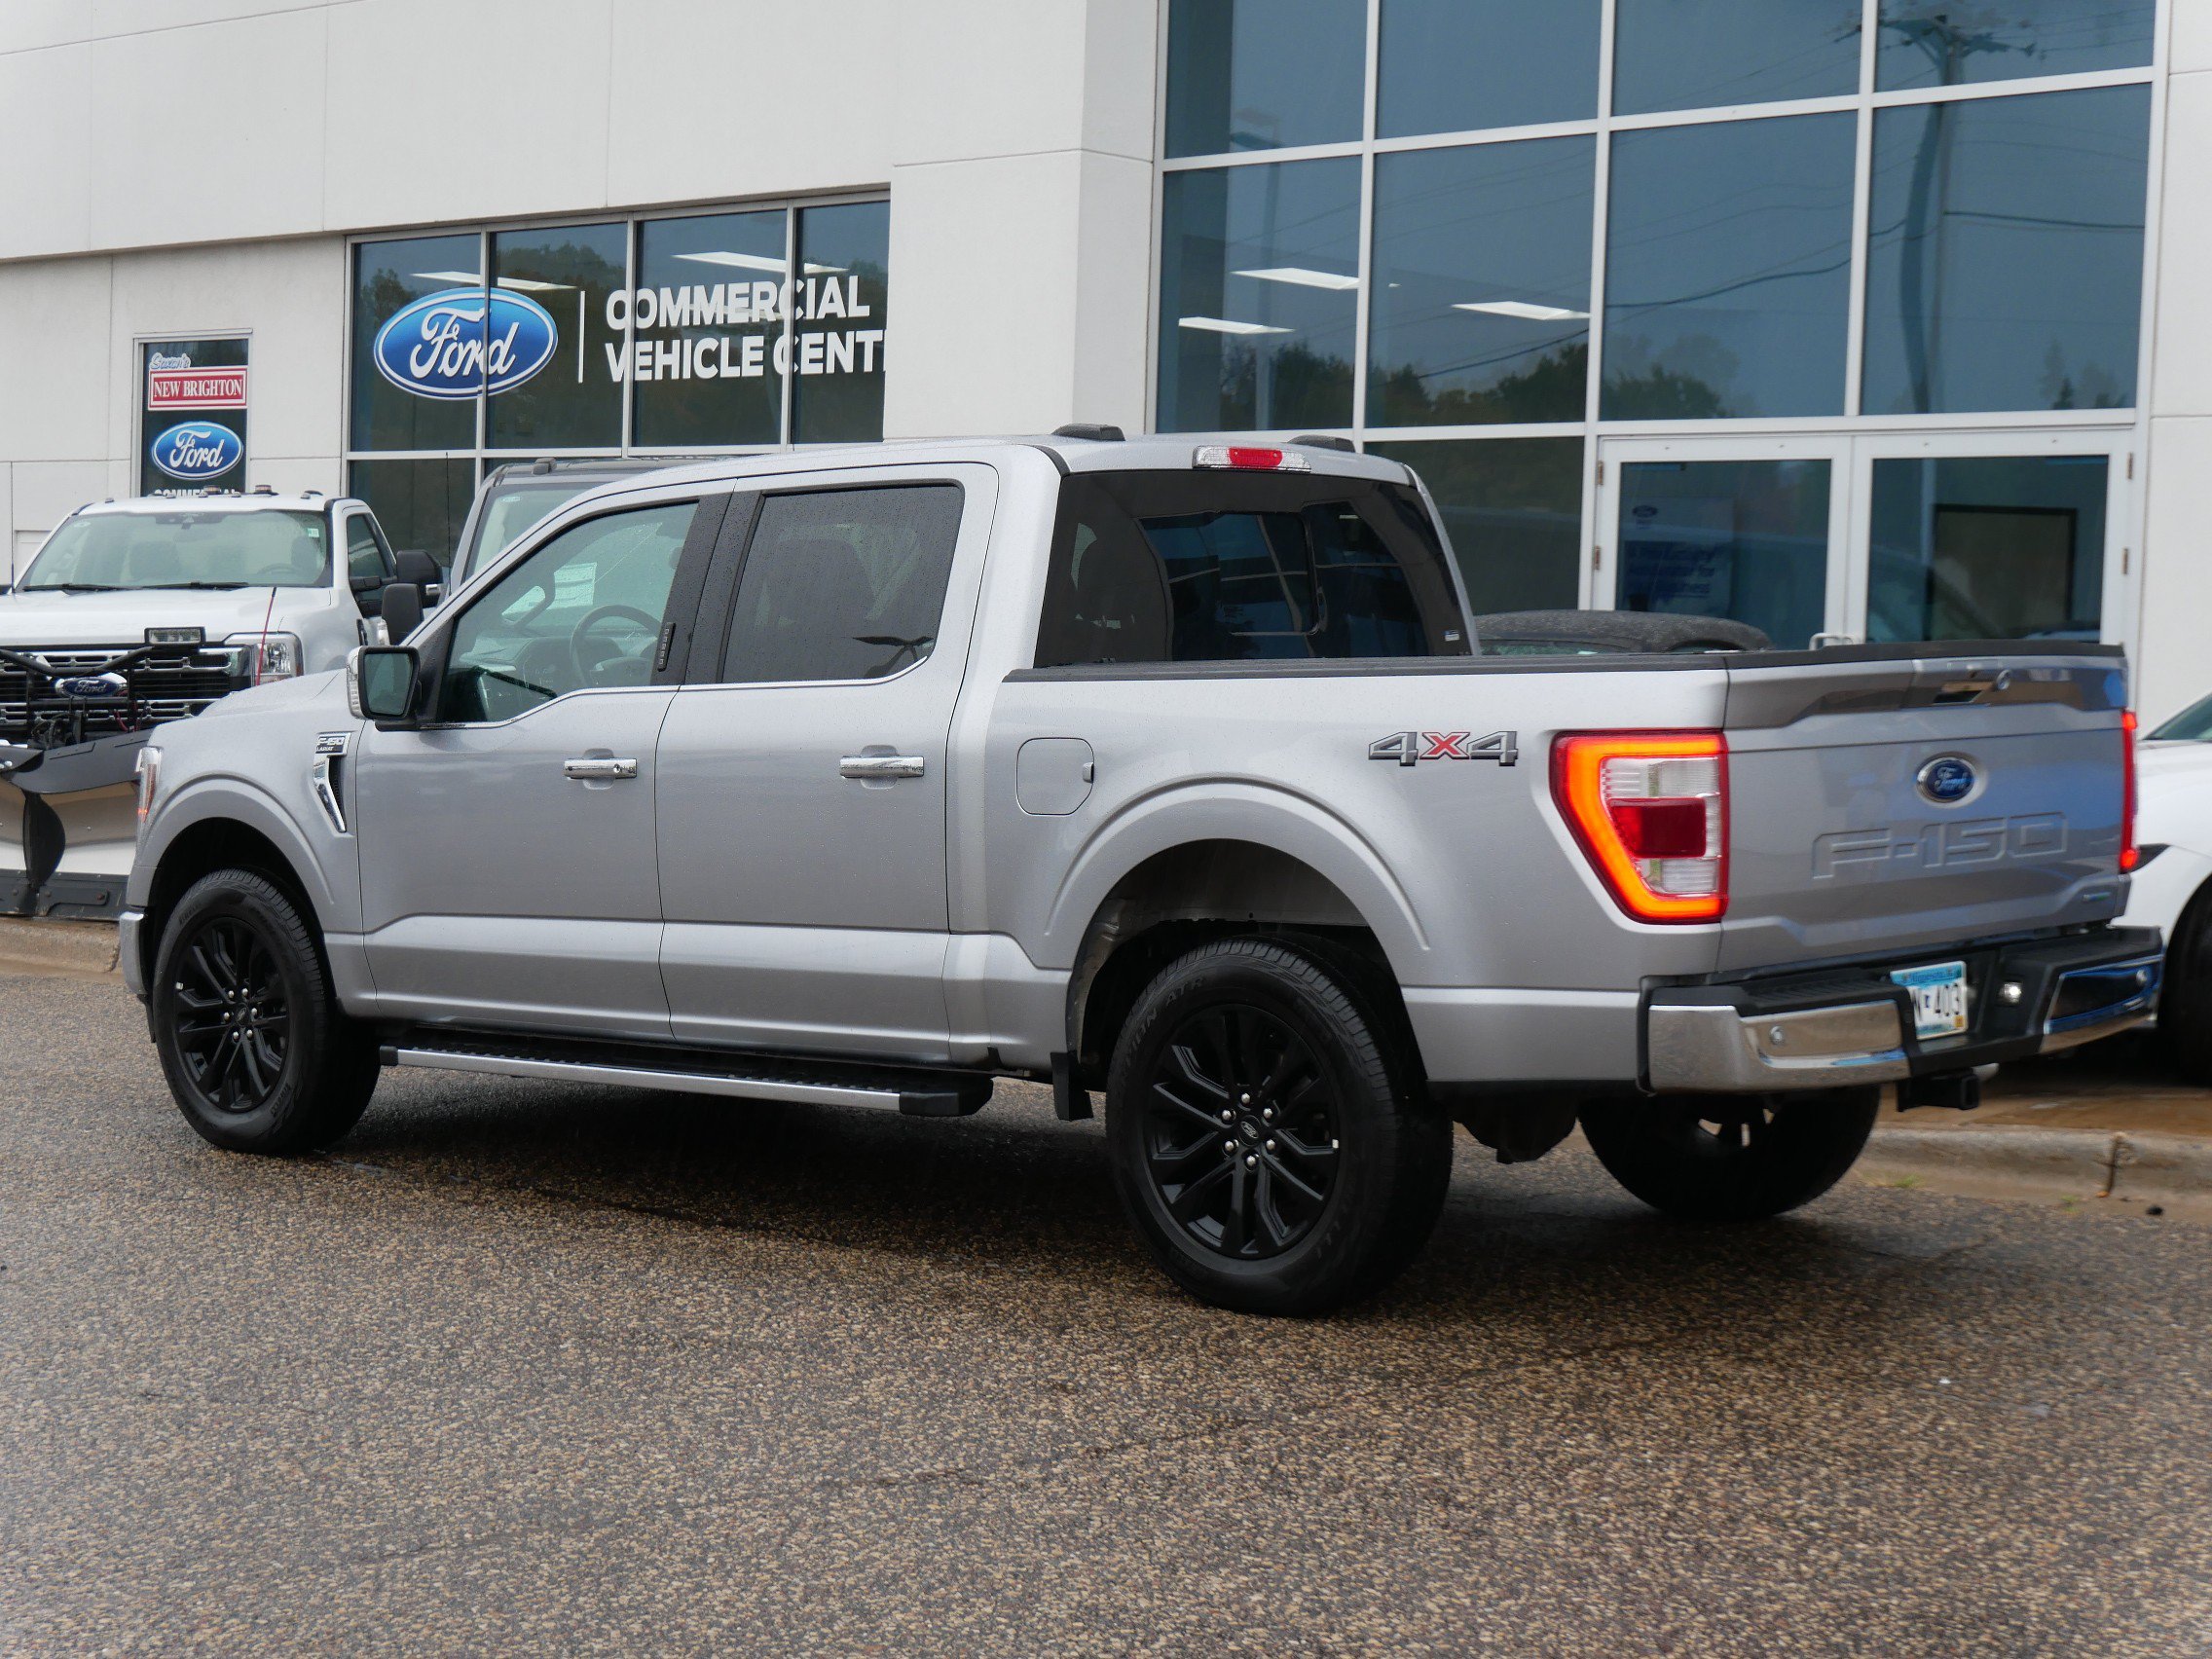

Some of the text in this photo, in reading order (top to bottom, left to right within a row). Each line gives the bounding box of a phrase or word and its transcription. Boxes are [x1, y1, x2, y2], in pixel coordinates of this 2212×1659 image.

[606, 276, 869, 329] COMMERCIAL
[409, 307, 518, 377] Ford
[606, 328, 887, 383] VEHICLE CENT
[154, 379, 243, 397] NEW BRIGHTON
[170, 430, 225, 467] Ford
[74, 680, 110, 693] Ford
[1812, 810, 2067, 880] F-150
